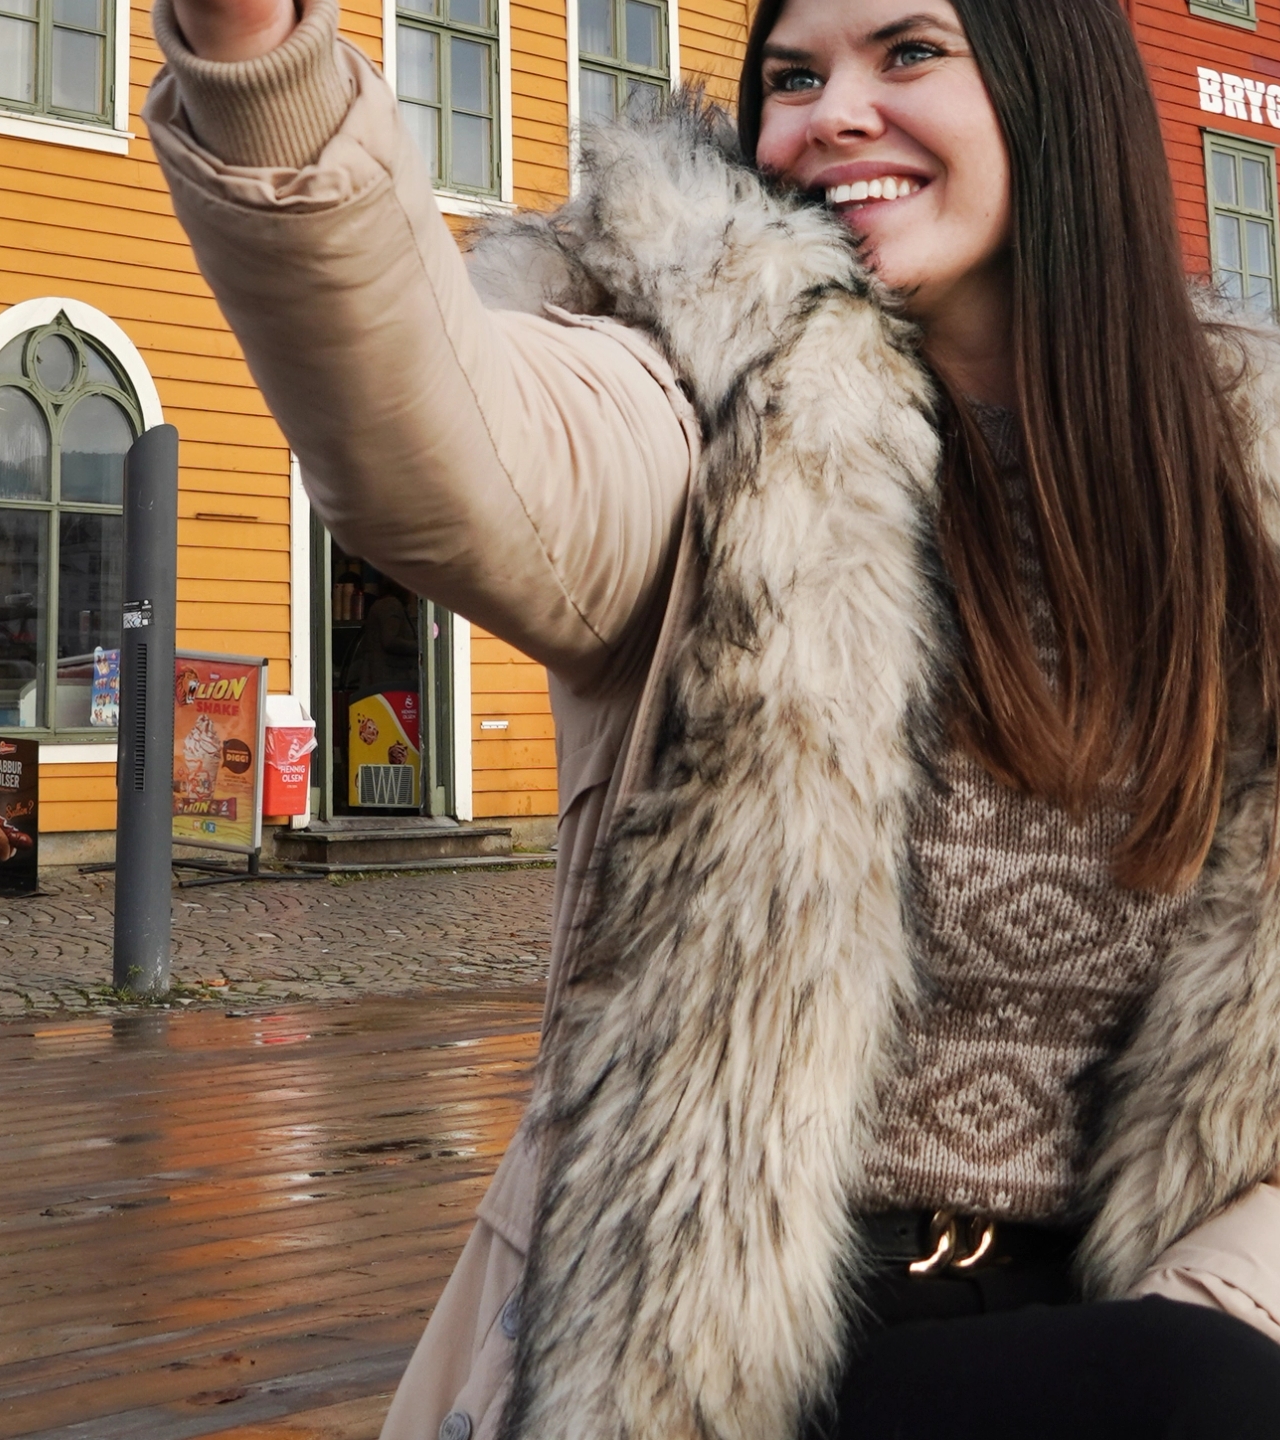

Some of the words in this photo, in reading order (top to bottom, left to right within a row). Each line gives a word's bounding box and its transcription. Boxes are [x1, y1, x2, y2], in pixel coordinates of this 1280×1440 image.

[195, 676, 248, 700] LION
[196, 701, 239, 716] SHAKE
[280, 765, 305, 773] HENNIG
[282, 774, 303, 782] OLSEN
[183, 800, 211, 813] LION
